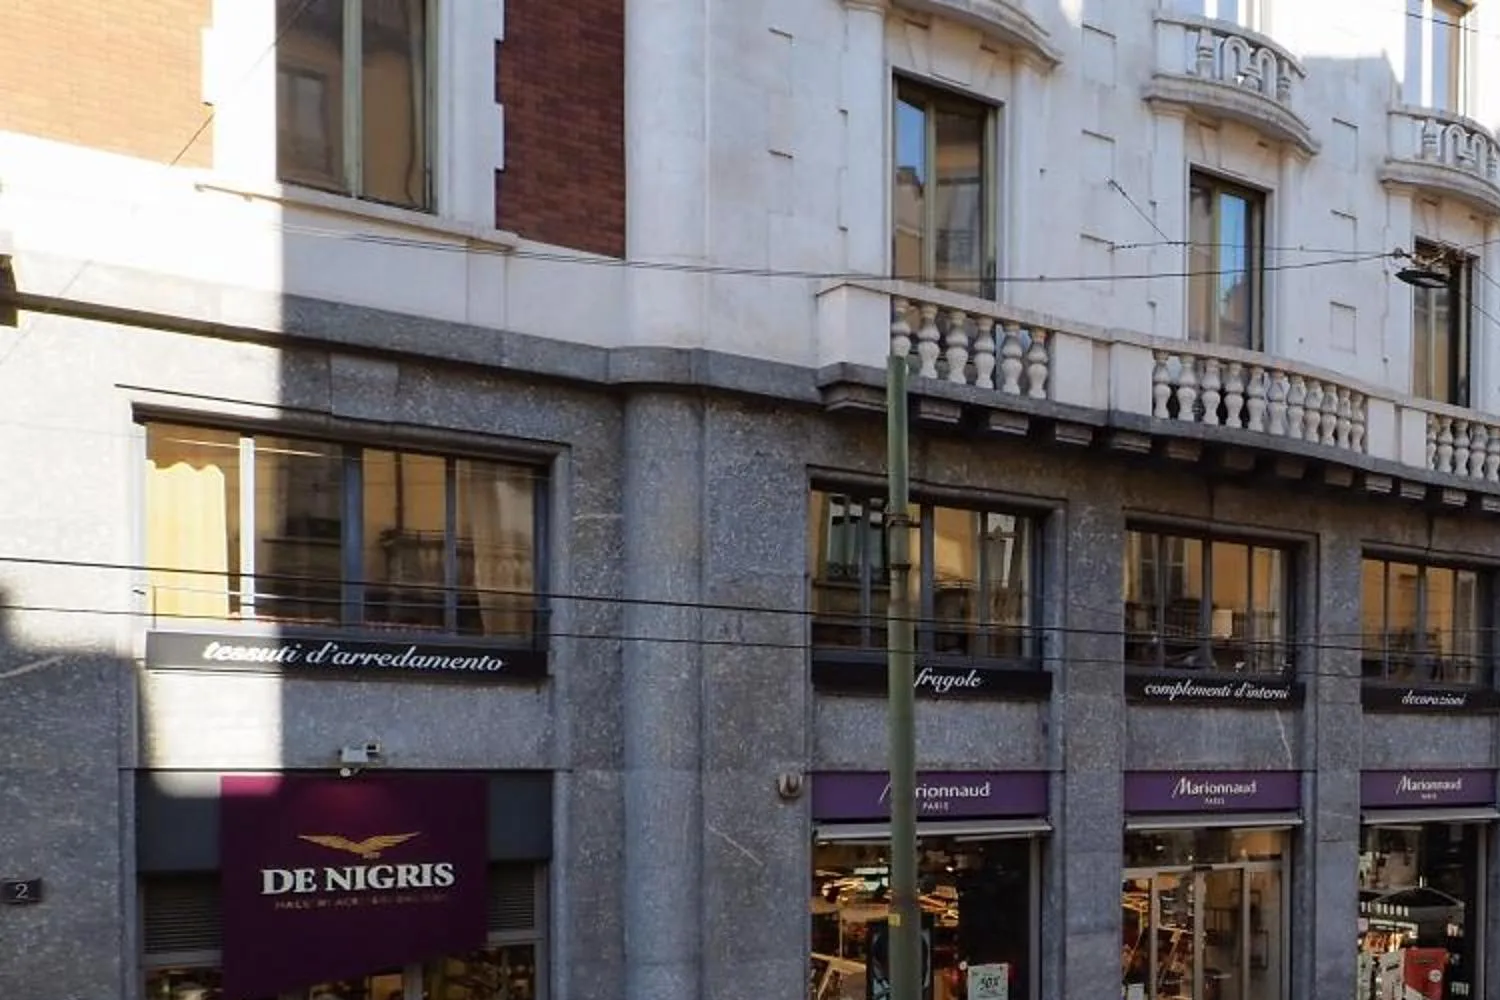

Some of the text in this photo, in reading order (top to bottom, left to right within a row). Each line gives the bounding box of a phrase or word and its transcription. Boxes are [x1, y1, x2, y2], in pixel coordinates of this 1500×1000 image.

[201, 641, 504, 671] tessuti d'arredamento
[913, 667, 984, 693] fragole
[1144, 679, 1290, 701] complementi d'interni
[1171, 775, 1257, 799] Marionnaud
[15, 883, 29, 899] 2
[260, 862, 456, 895] DE NIGRIS
